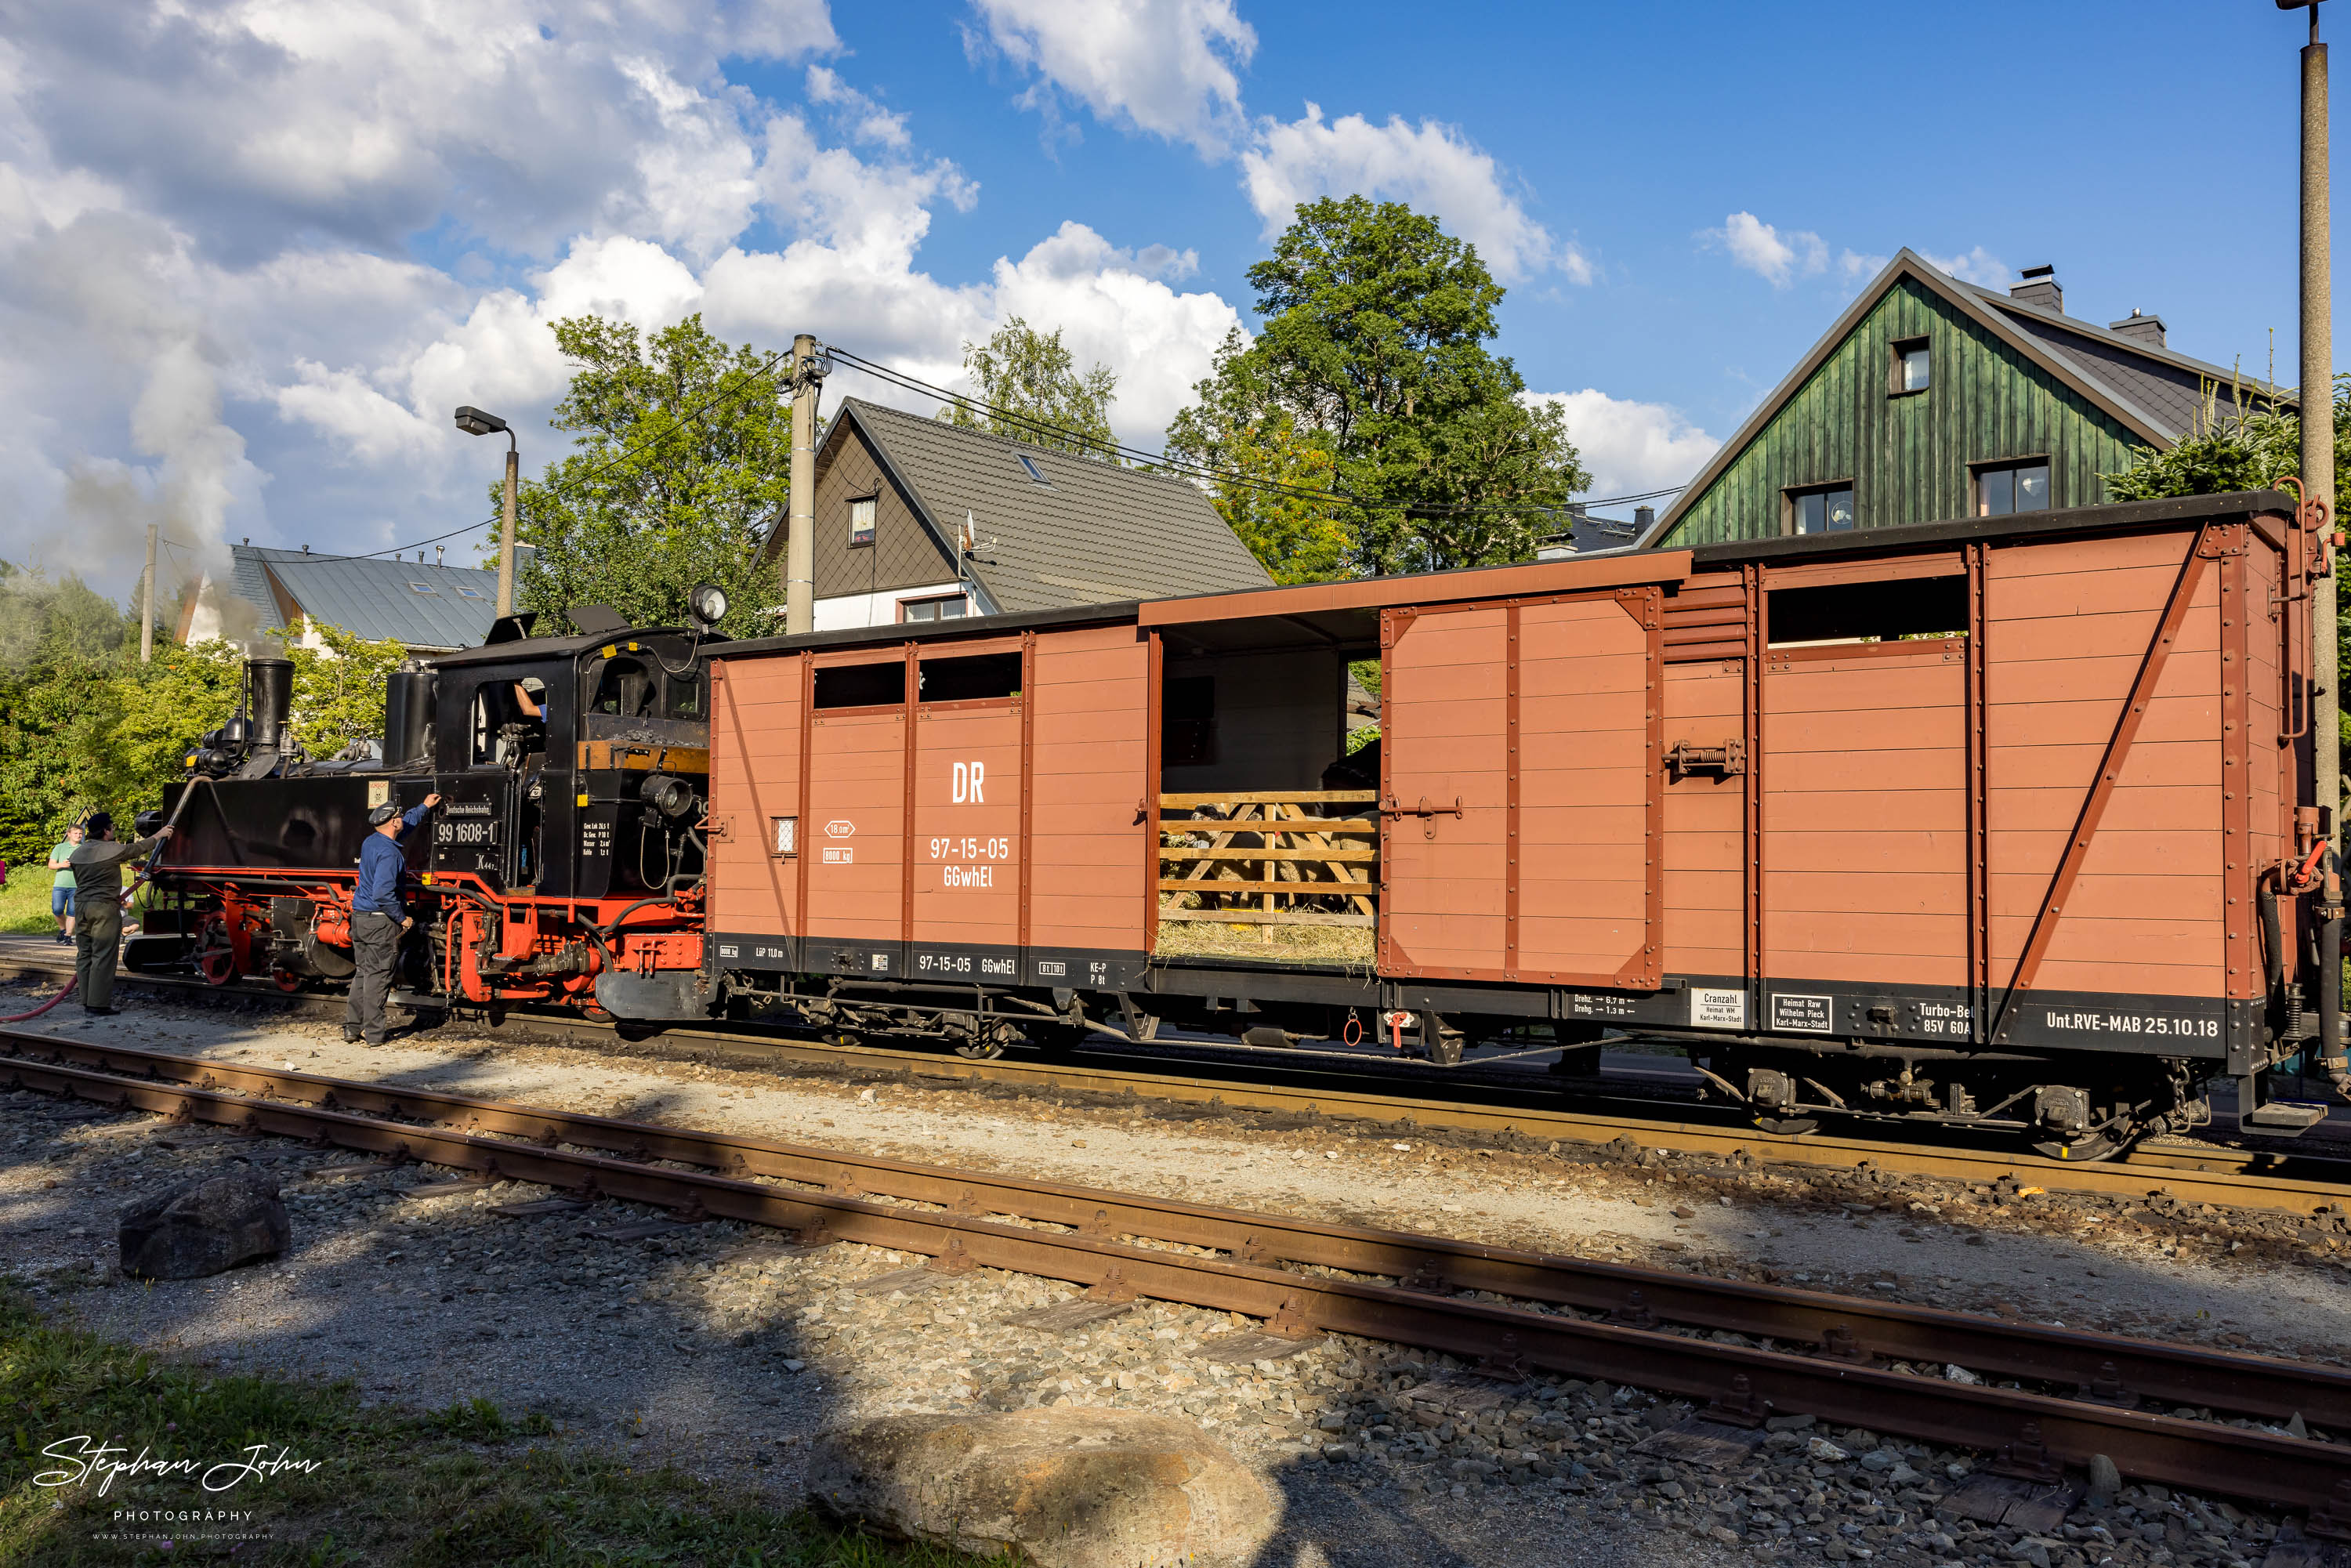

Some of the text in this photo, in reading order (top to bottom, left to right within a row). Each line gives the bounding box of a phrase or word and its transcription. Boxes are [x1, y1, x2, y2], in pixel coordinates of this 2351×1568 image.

[952, 762, 984, 803] DR
[446, 805, 489, 813] Deutsche Reichsbahn
[438, 823, 494, 842] 99 1608-1
[930, 838, 1009, 859] 97-15-05
[825, 850, 850, 863] 8000 kg
[944, 866, 993, 887] GGwhEl
[755, 947, 766, 957] LüP
[919, 955, 1016, 975] 97-15-05 GGwhEl
[1090, 961, 1107, 973] KE-P
[1090, 974, 1096, 984] P
[1574, 994, 1593, 1003] Drehz.
[1704, 994, 1737, 1004] Cranzahl
[1783, 998, 1820, 1009] Heimat Raw
[1574, 1004, 1593, 1015] Drehg.
[1779, 1008, 1824, 1019] Wilhelm Pieck
[1700, 1014, 1742, 1023] Karl-Marx-Stadt
[1776, 1018, 1828, 1029] Karl-Marx-Stadt
[1924, 1019, 1972, 1034] 85V 60A
[2145, 1017, 2219, 1037] 25.10.18
